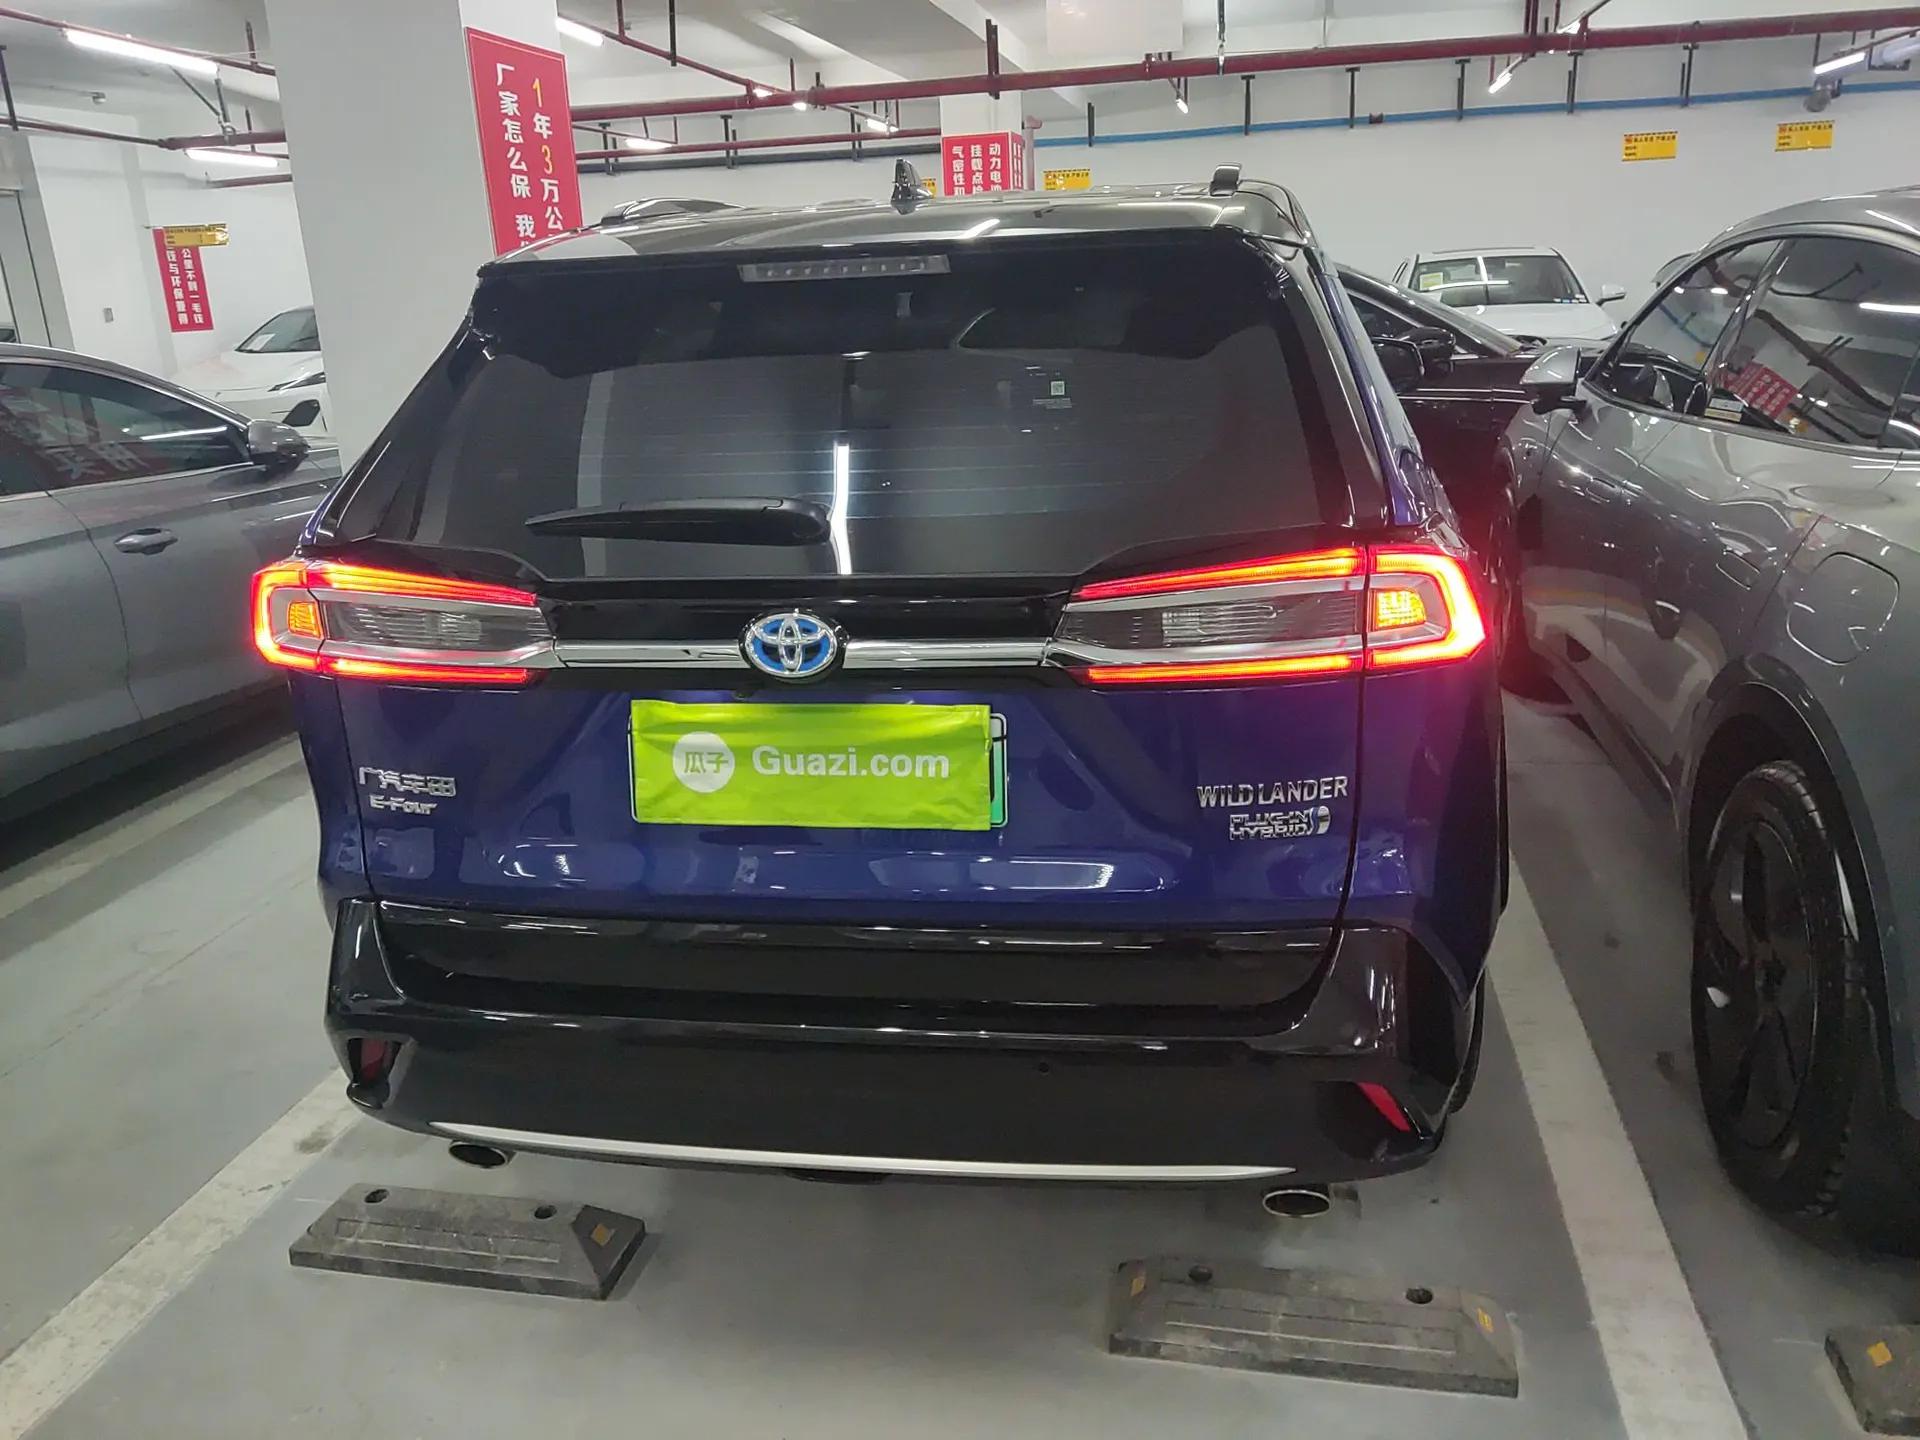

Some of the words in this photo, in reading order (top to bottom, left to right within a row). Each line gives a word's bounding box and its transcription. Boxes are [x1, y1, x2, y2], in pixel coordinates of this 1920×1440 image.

[495, 62, 532, 199] 厂家怎么保
[515, 213, 537, 247] 我
[531, 77, 564, 238] 1年3万公
[683, 751, 729, 774] 瓜子
[752, 745, 950, 778] Guazi.com
[359, 766, 456, 797] 广汽丰田
[1229, 823, 1310, 841] HYBRID
